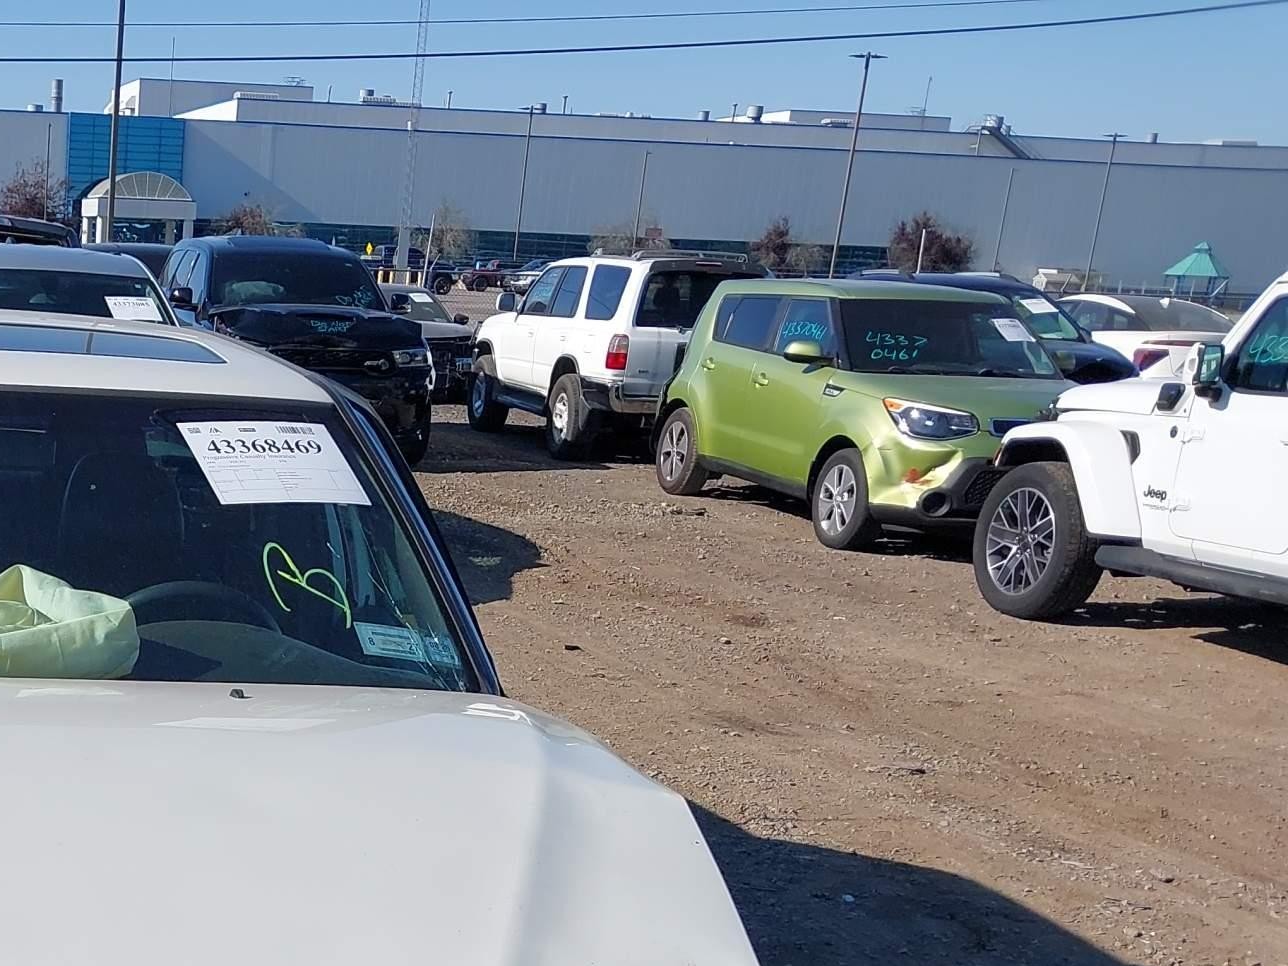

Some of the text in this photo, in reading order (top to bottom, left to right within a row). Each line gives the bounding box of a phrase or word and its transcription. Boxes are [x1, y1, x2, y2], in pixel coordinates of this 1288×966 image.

[865, 330, 928, 347] 4337
[871, 348, 919, 361] 0461
[207, 438, 322, 455] 43368469
[1143, 484, 1168, 503] Jeep
